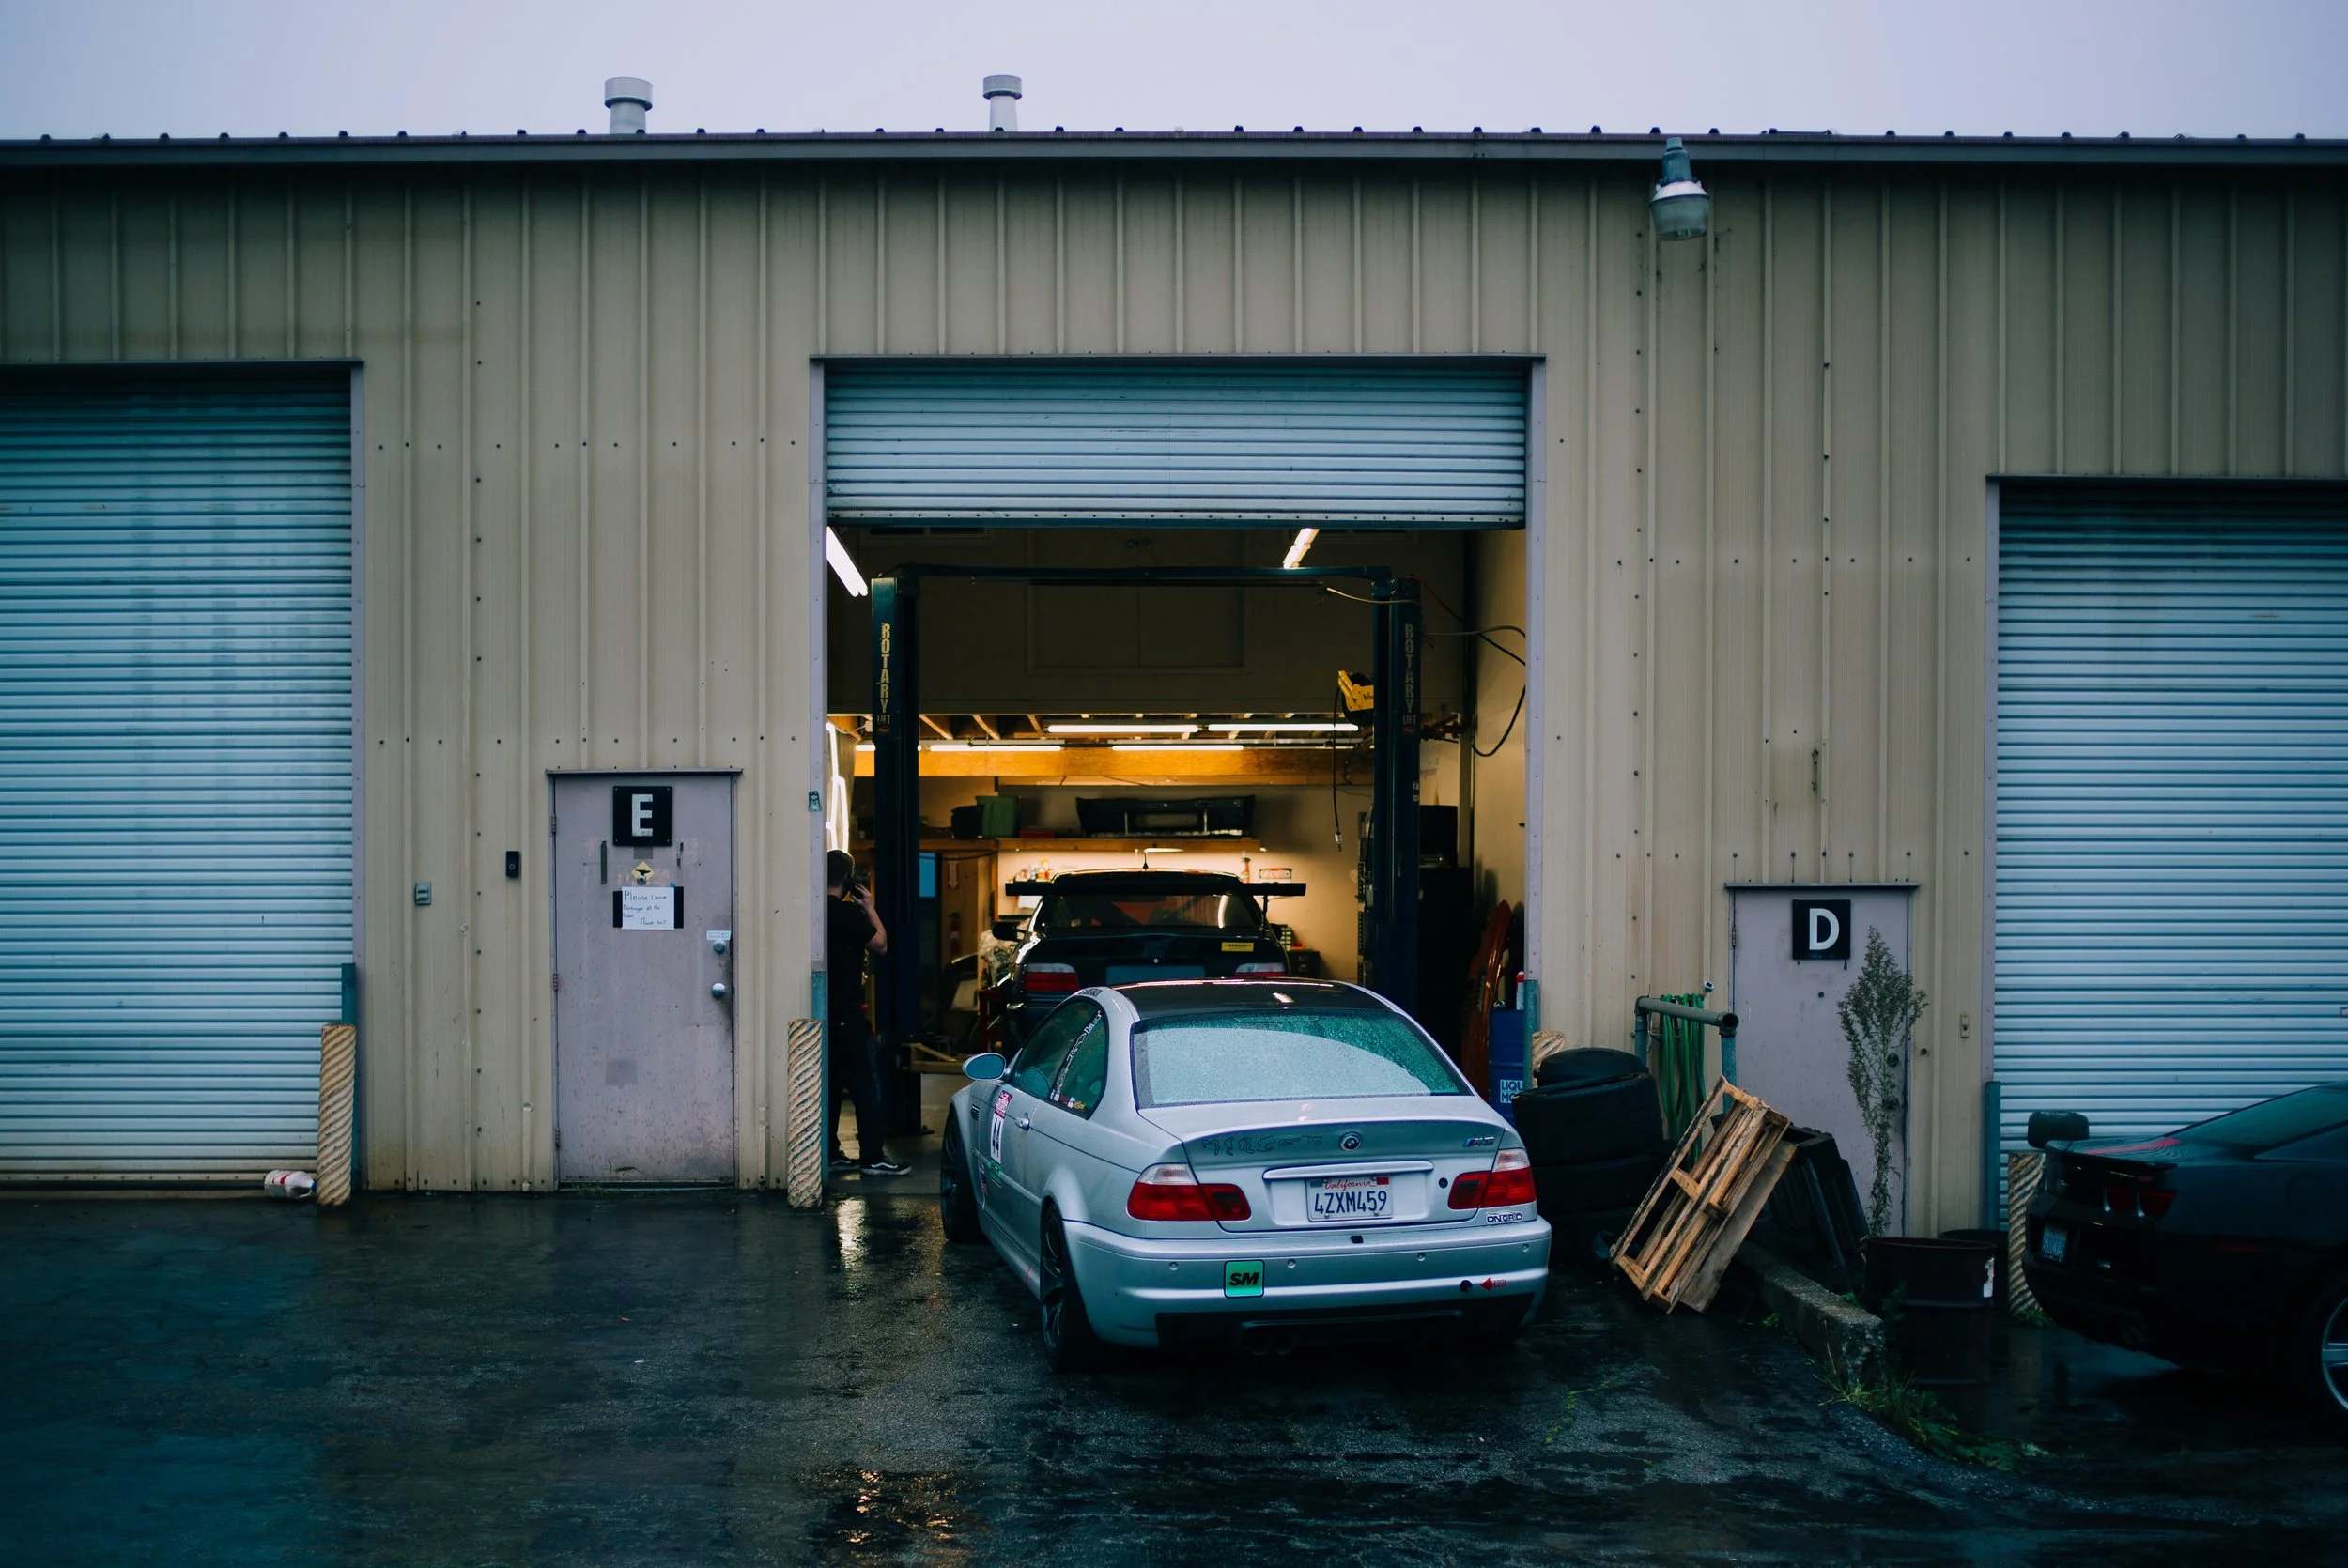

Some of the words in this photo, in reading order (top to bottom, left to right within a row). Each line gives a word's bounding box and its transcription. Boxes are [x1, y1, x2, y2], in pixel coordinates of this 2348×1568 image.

[880, 623, 890, 714] ROTARY
[1404, 623, 1414, 714] ROTARY
[877, 715, 890, 725] LIFT
[1402, 715, 1416, 725] LIFT
[631, 793, 653, 837] E
[624, 890, 648, 901] Please
[1809, 908, 1840, 951] D
[1324, 1178, 1377, 1191] California
[1315, 1190, 1387, 1214] 4ZXM459
[1228, 1272, 1259, 1286] SM
